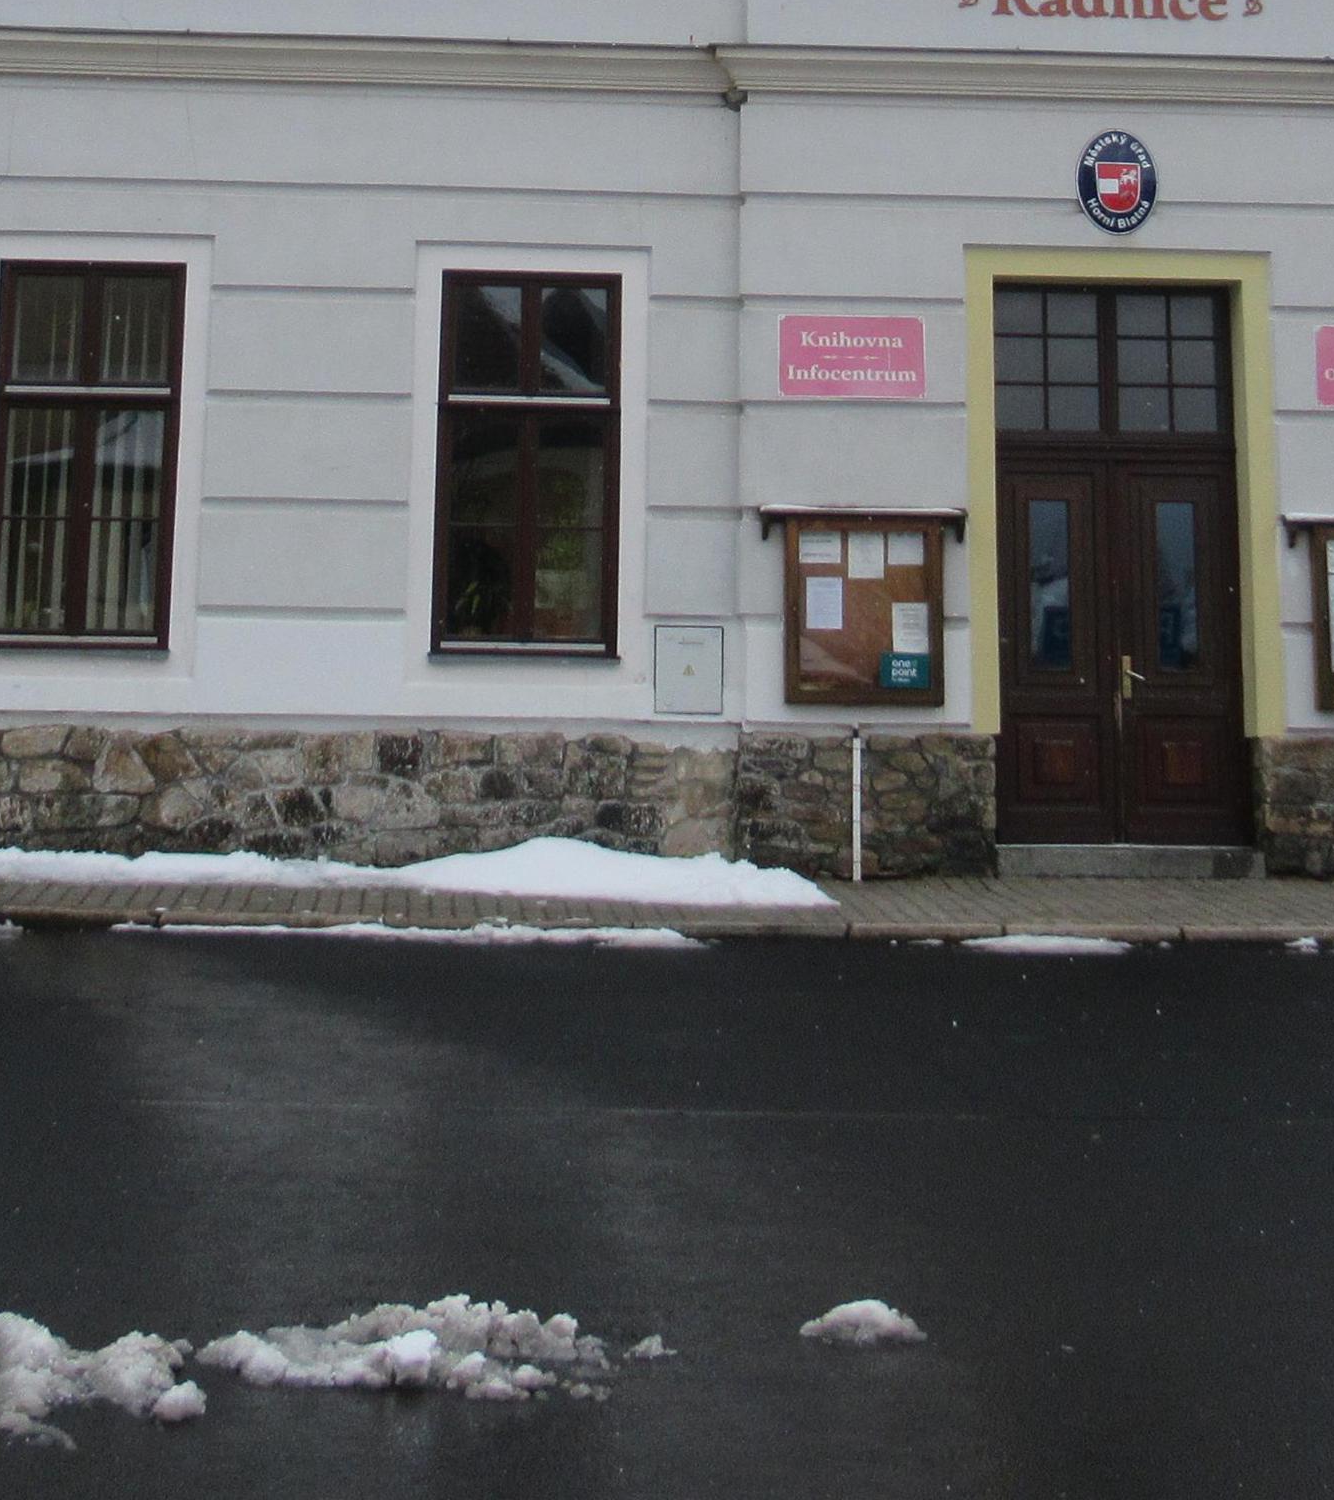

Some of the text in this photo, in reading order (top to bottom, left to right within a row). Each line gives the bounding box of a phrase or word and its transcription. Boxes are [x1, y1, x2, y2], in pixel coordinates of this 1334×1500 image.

[1087, 198, 1116, 227] Horní
[800, 331, 904, 349] Knihovna
[787, 364, 917, 382] Infocentrum
